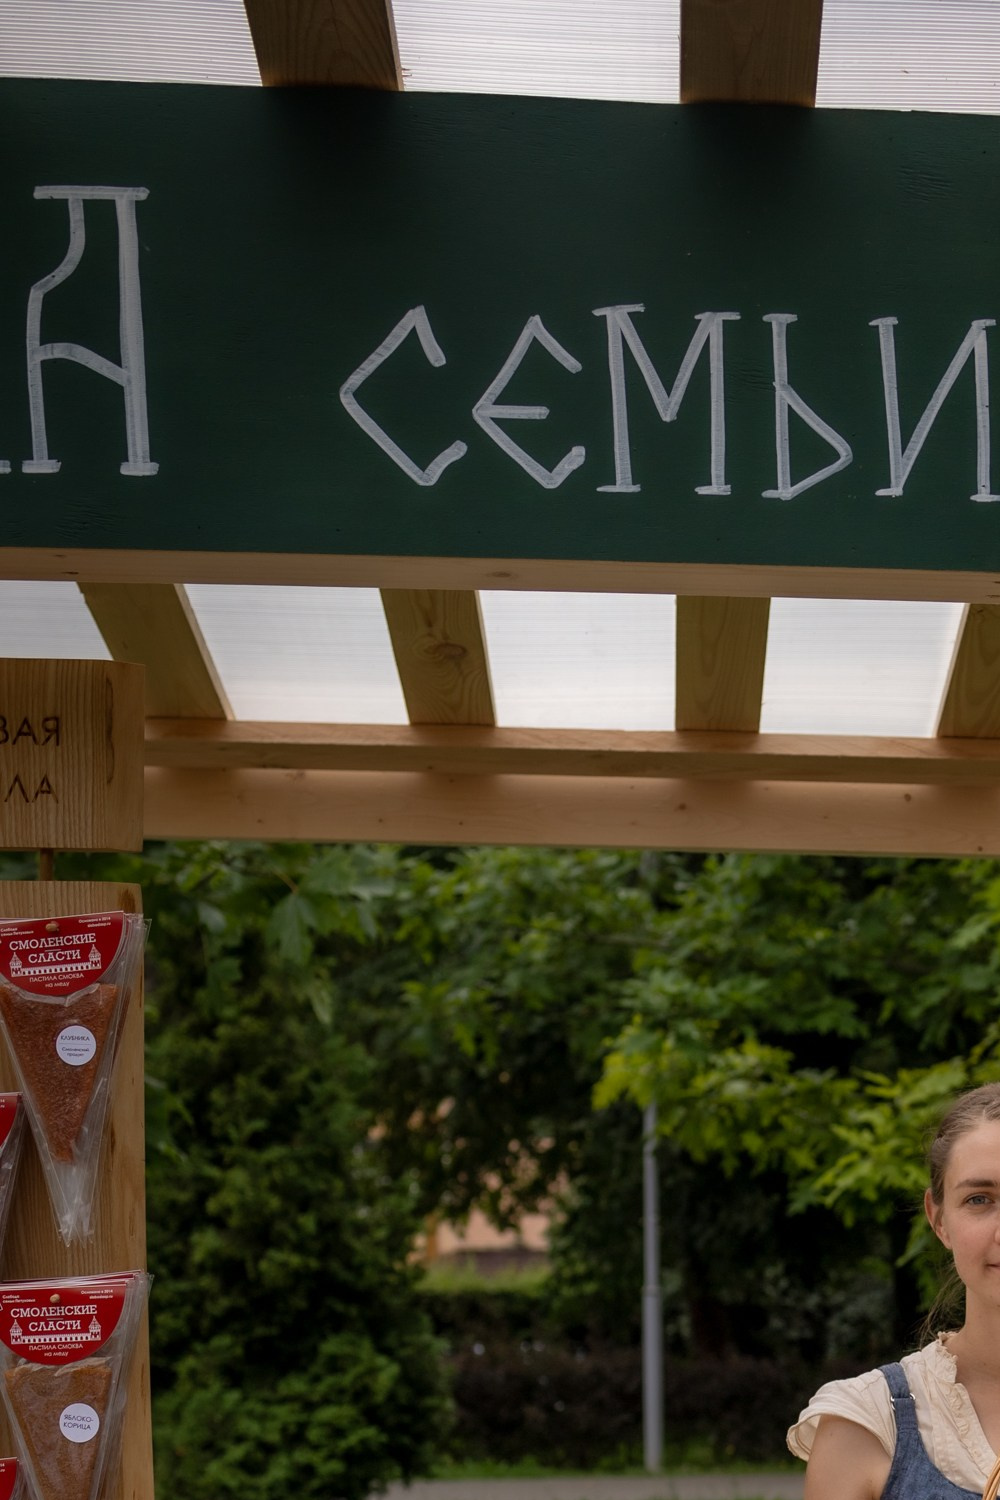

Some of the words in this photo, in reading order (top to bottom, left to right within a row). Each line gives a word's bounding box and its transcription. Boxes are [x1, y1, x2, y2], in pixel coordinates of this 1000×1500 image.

[0, 185, 159, 476] А
[9, 933, 97, 951] СМОЛЕНСКИЕ
[28, 949, 82, 963] СЛАСТИ
[29, 975, 58, 983] ПАСТИЛА
[58, 972, 84, 981] СМОКВА
[10, 1305, 97, 1318] СМОЛЕНСКИЕ
[28, 1320, 82, 1332] СЛАСТИ
